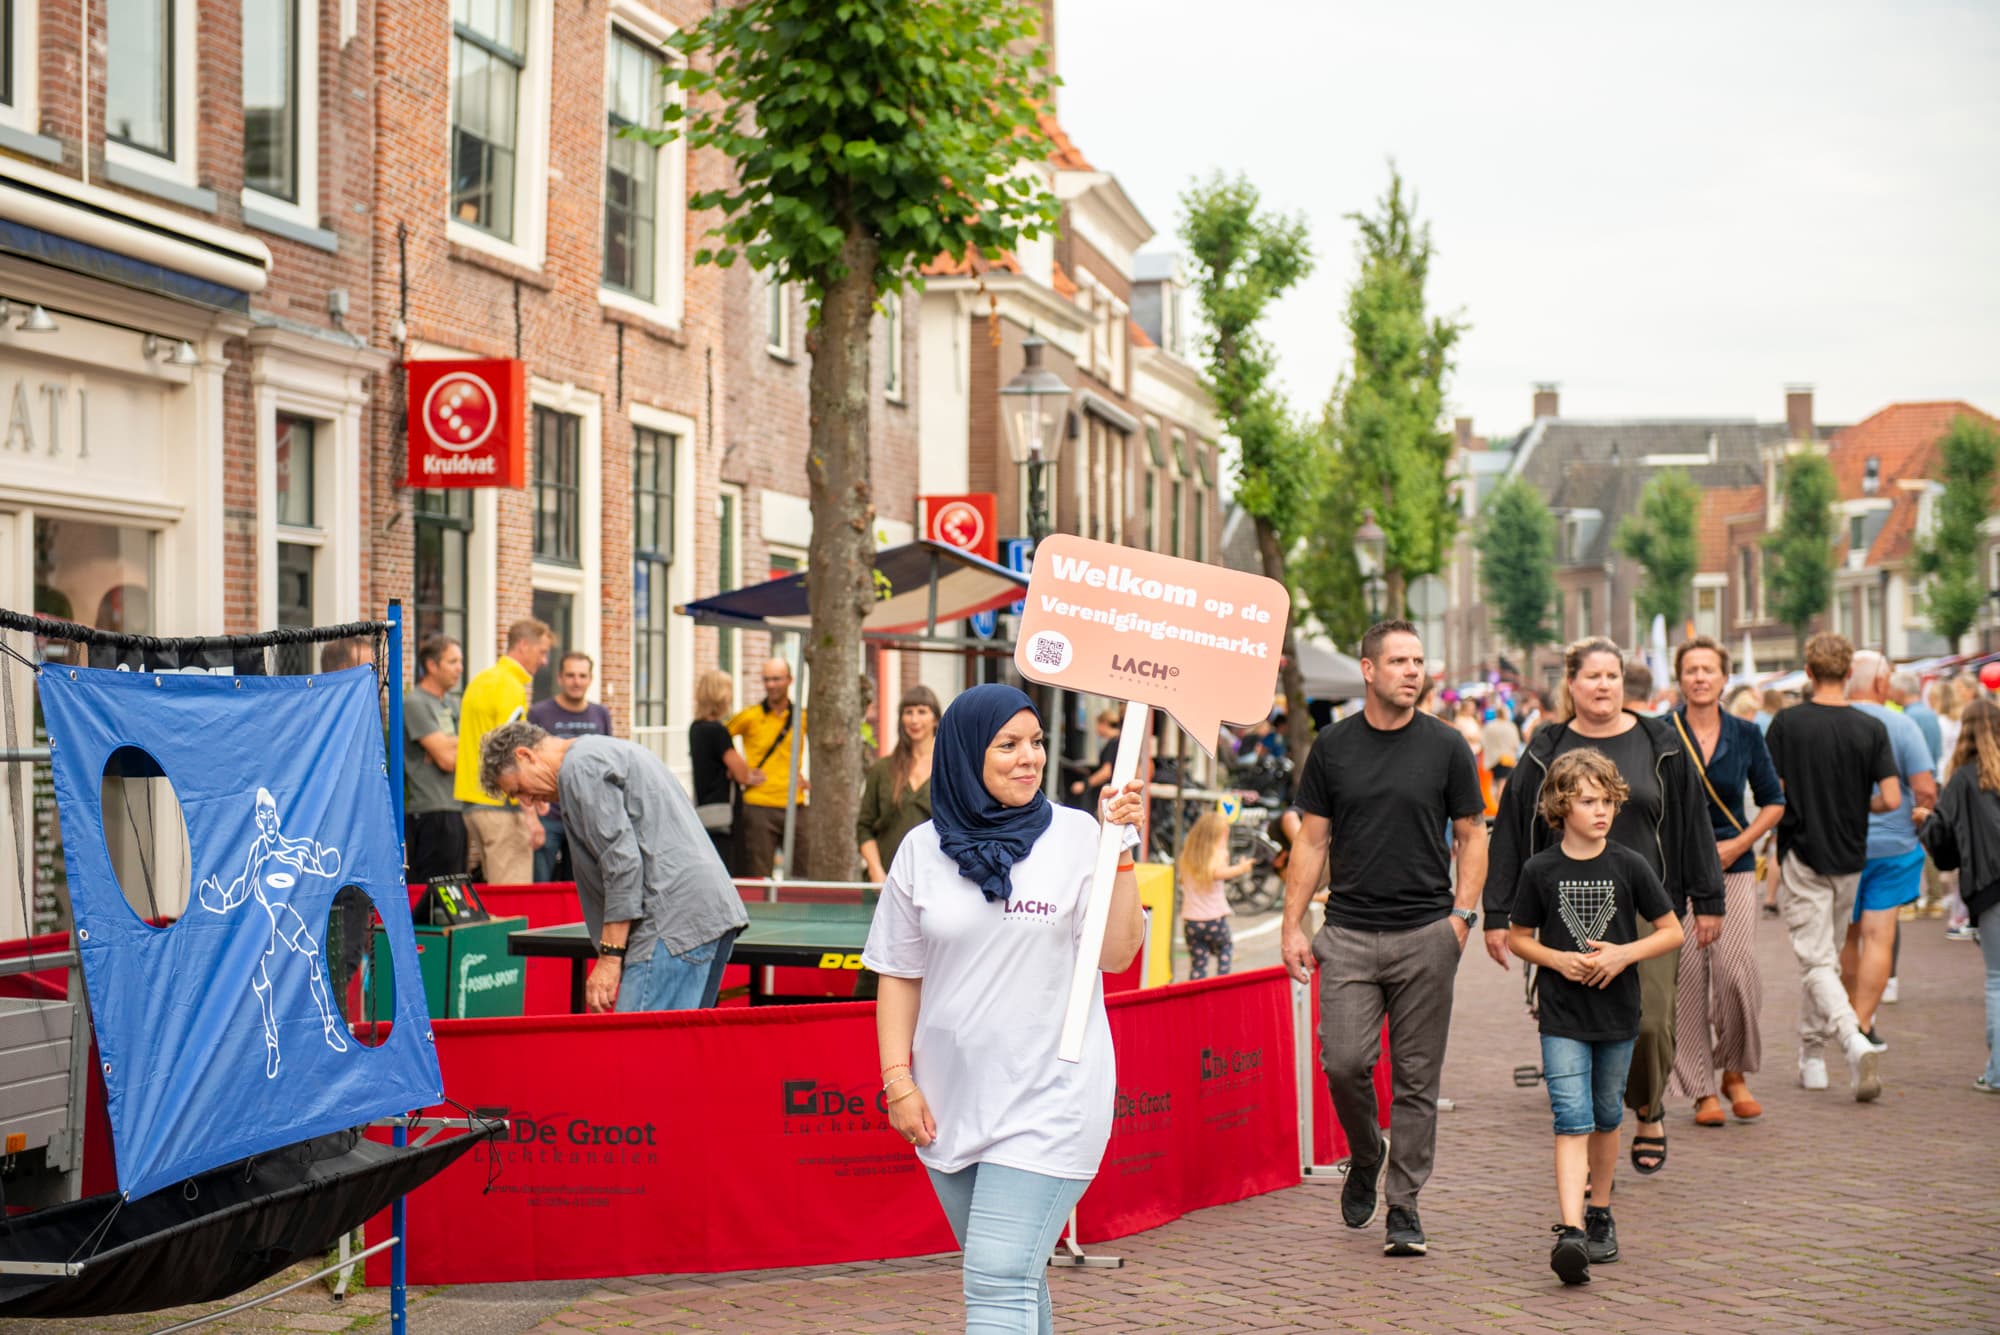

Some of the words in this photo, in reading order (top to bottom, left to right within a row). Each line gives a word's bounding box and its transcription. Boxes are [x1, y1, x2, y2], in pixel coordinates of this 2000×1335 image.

[423, 453, 496, 474] Kruidvat
[1051, 554, 1197, 608] Welkom
[1204, 598, 1233, 618] op
[1241, 604, 1270, 624] de
[1040, 595, 1268, 659] Verenigingenmarkt
[821, 1091, 865, 1116] De
[1118, 1095, 1136, 1118] De
[1139, 1091, 1171, 1116] Groot
[514, 1119, 556, 1144] De
[567, 1119, 656, 1145] Groot
[474, 1146, 657, 1165] Luchtkanalen
